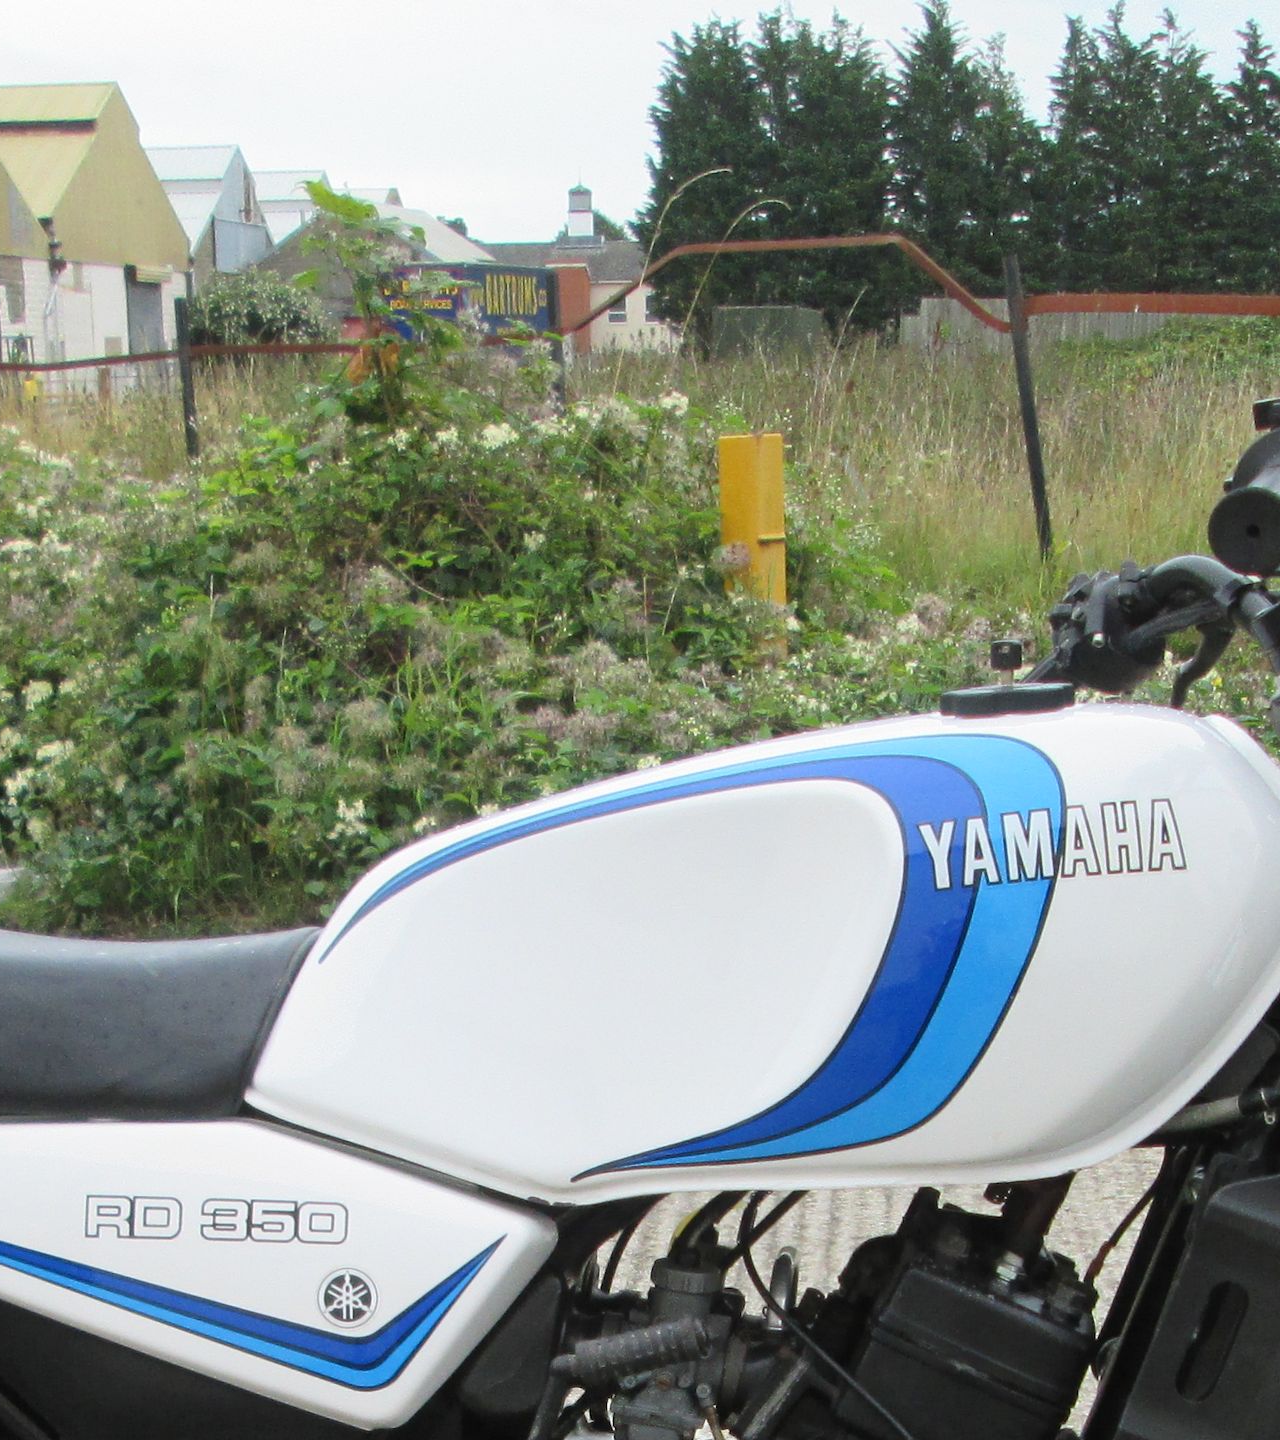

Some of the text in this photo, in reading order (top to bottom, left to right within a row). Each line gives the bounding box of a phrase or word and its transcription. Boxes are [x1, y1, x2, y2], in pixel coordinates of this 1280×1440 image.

[917, 798, 1187, 891] YAMAHA
[85, 1194, 348, 1244] RD 350
